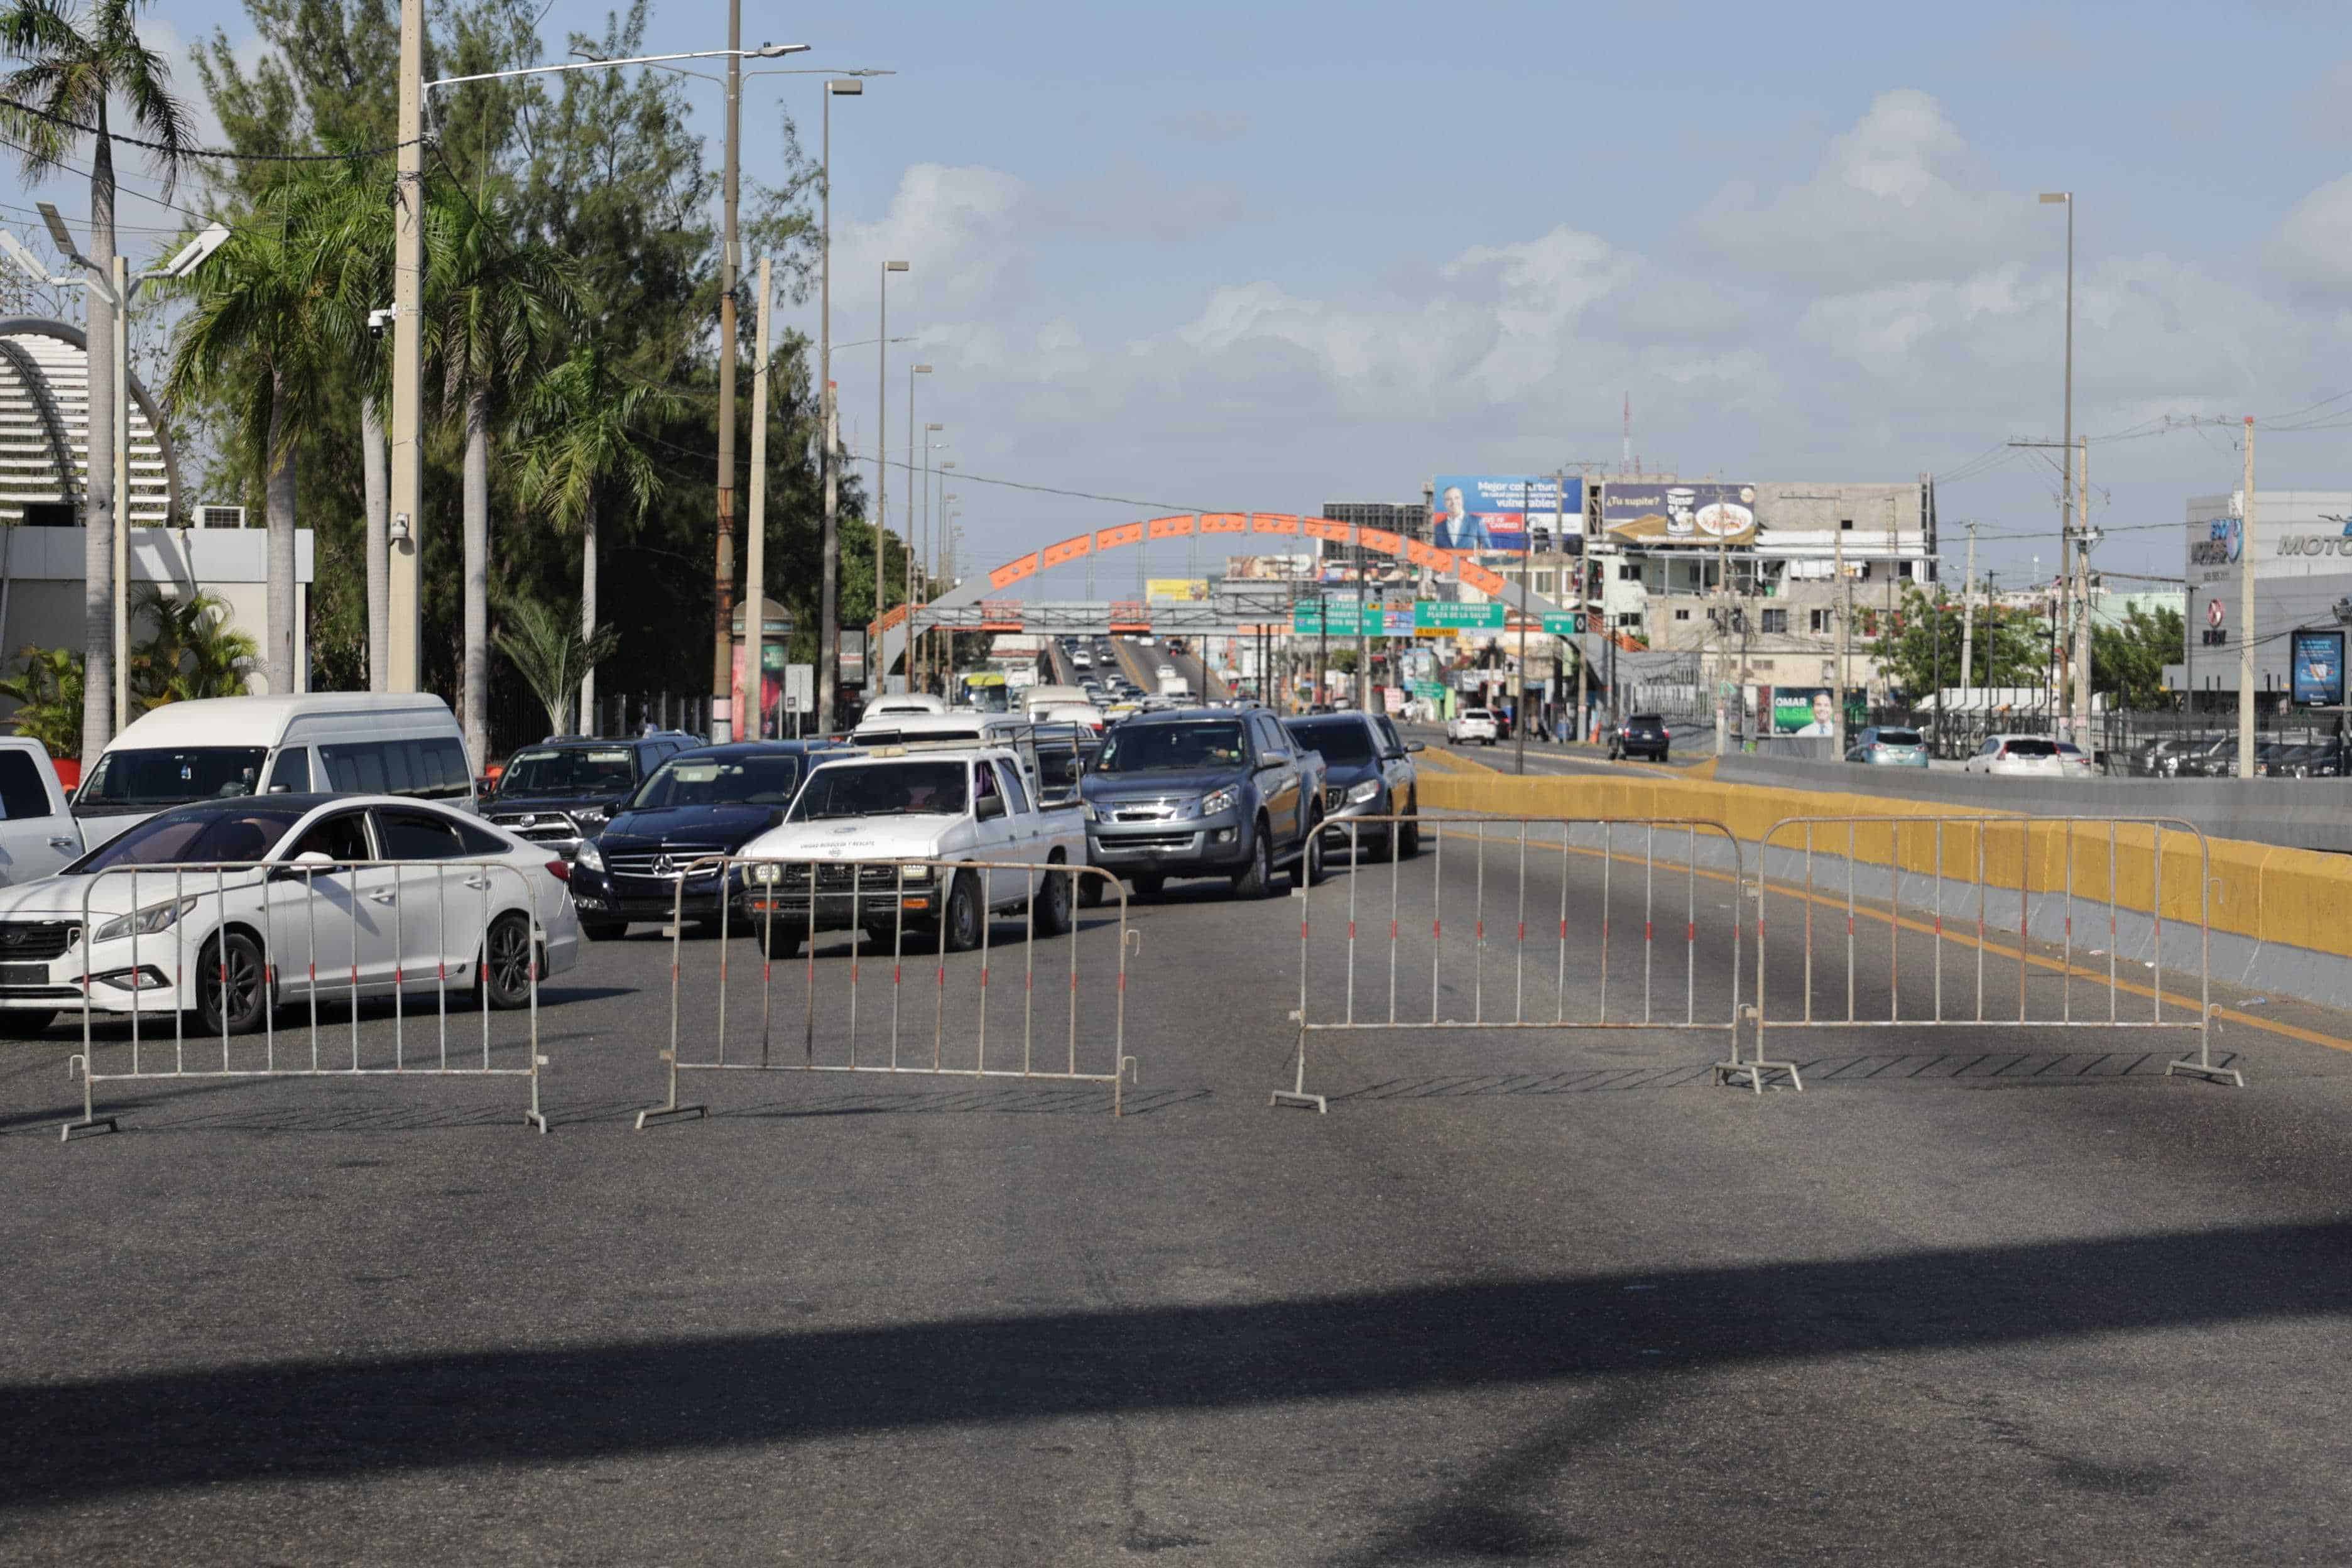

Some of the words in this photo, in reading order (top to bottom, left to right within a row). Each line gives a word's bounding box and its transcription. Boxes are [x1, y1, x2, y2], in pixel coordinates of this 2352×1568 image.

[1478, 482, 1506, 492] Mejor
[1607, 496, 1622, 507] ¿Tu
[1625, 496, 1660, 507] supite?
[1775, 697, 1807, 707] OMAR
